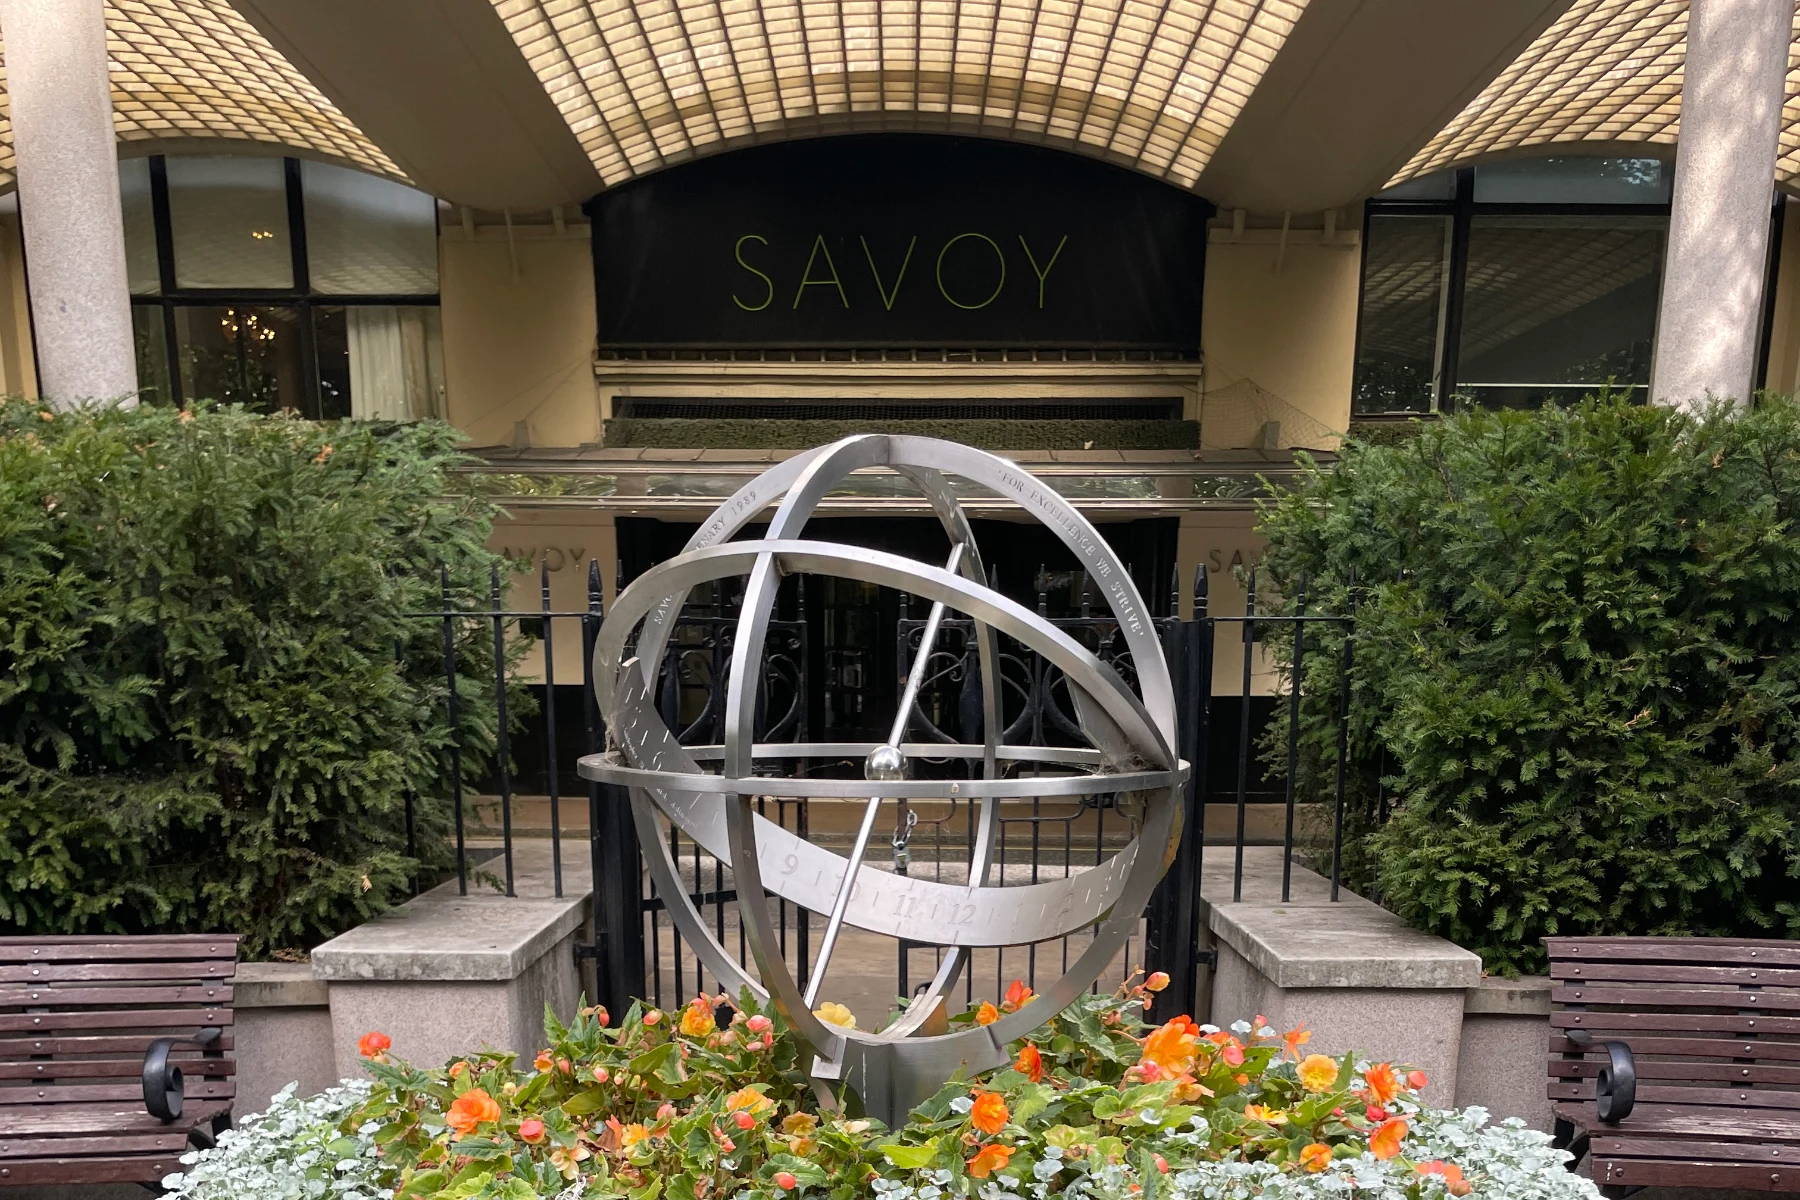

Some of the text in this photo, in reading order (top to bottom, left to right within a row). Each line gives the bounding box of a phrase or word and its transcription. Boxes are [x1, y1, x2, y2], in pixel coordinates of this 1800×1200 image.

[732, 233, 1068, 312] SAVOY
[731, 490, 757, 517] 1989
[1029, 489, 1098, 558] EXCELLENCE
[1095, 556, 1113, 578] WE
[780, 853, 800, 876] 9
[892, 894, 918, 919] 11
[947, 903, 977, 926] 12
